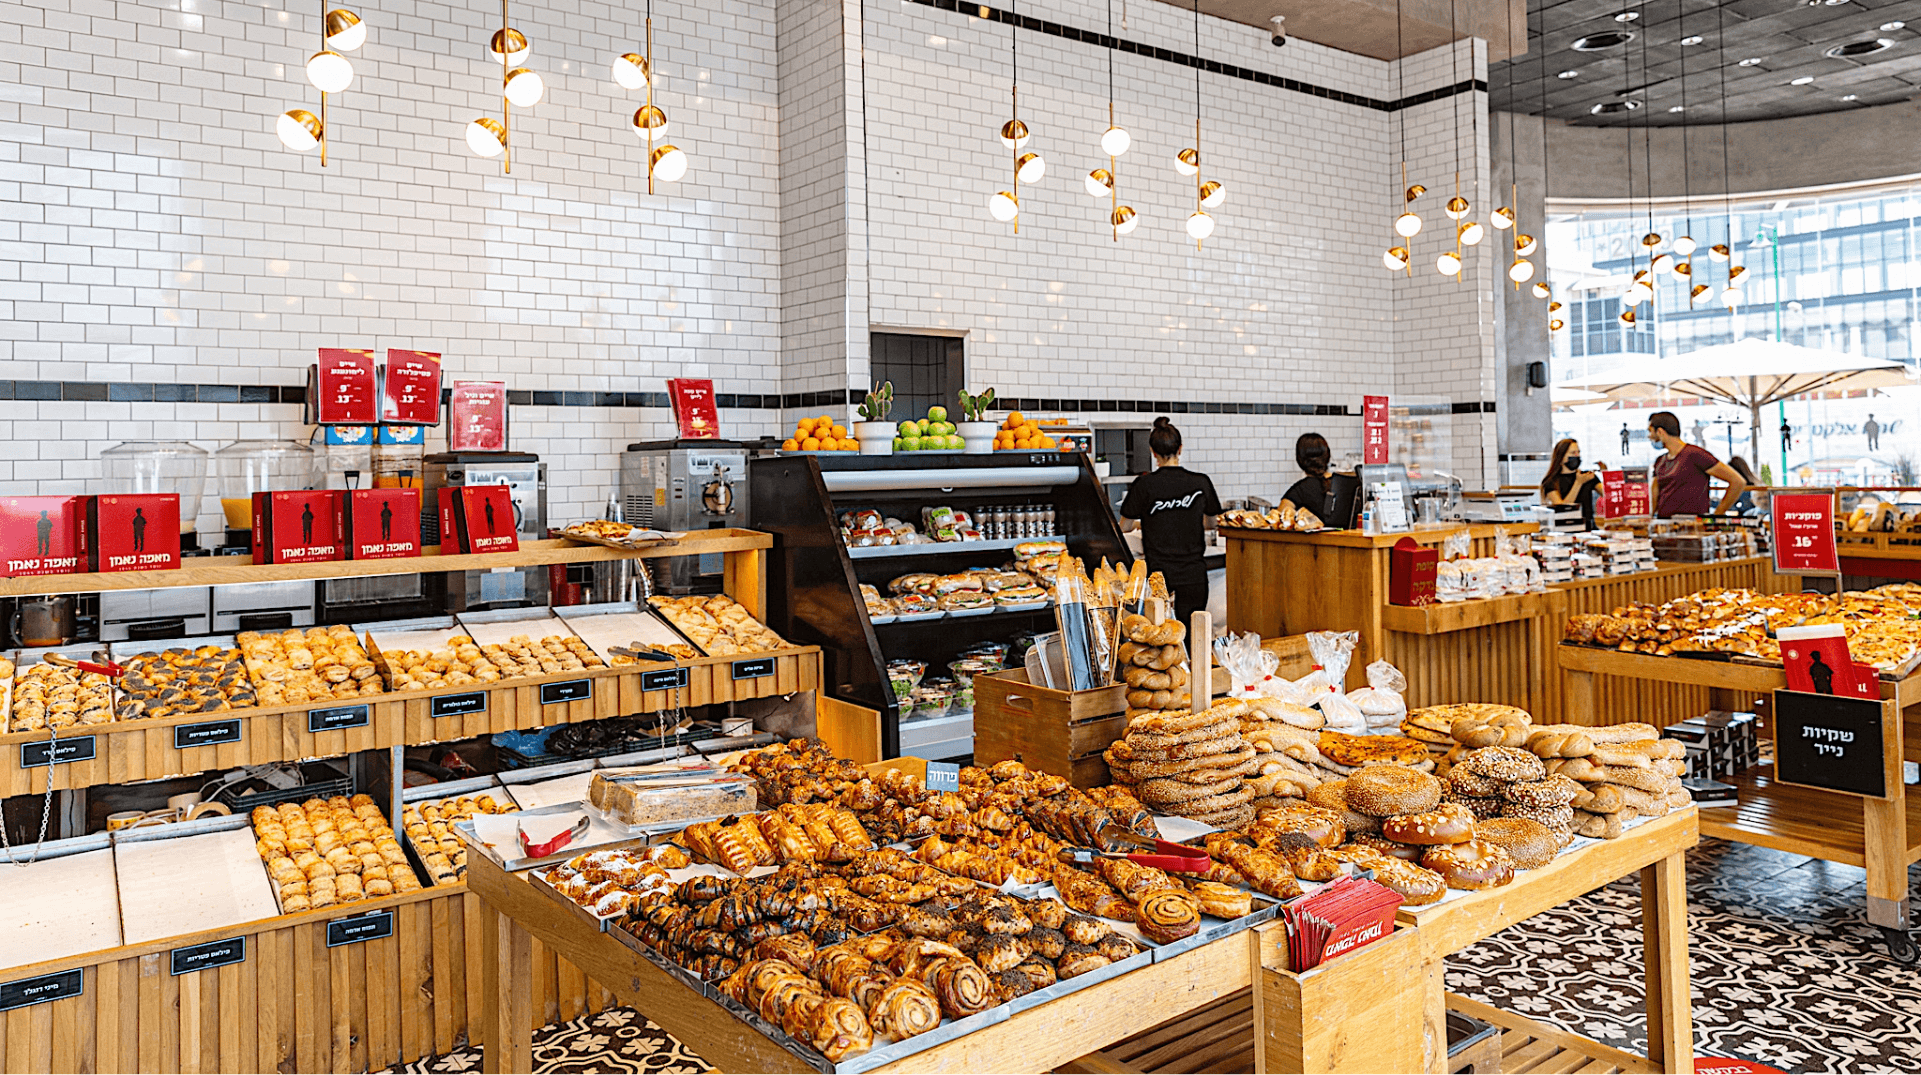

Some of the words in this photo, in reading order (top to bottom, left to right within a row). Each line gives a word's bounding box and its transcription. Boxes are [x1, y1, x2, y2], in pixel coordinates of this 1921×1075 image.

[475, 537, 492, 548] נאמן
[492, 536, 512, 545] מאפה
[308, 546, 335, 556] מאפה
[361, 544, 384, 556] נאמן
[386, 542, 413, 552] מאפה
[139, 553, 171, 564] מאפה
[281, 548, 306, 560] נאמן
[7, 559, 40, 572] נאמן
[109, 555, 136, 568] נאמן
[1802, 726, 1854, 742] שקיות
[1814, 742, 1844, 758] נייר
[929, 770, 958, 782] פרווה
[1325, 934, 1356, 957] מאפה
[1357, 920, 1384, 944] נאמן
